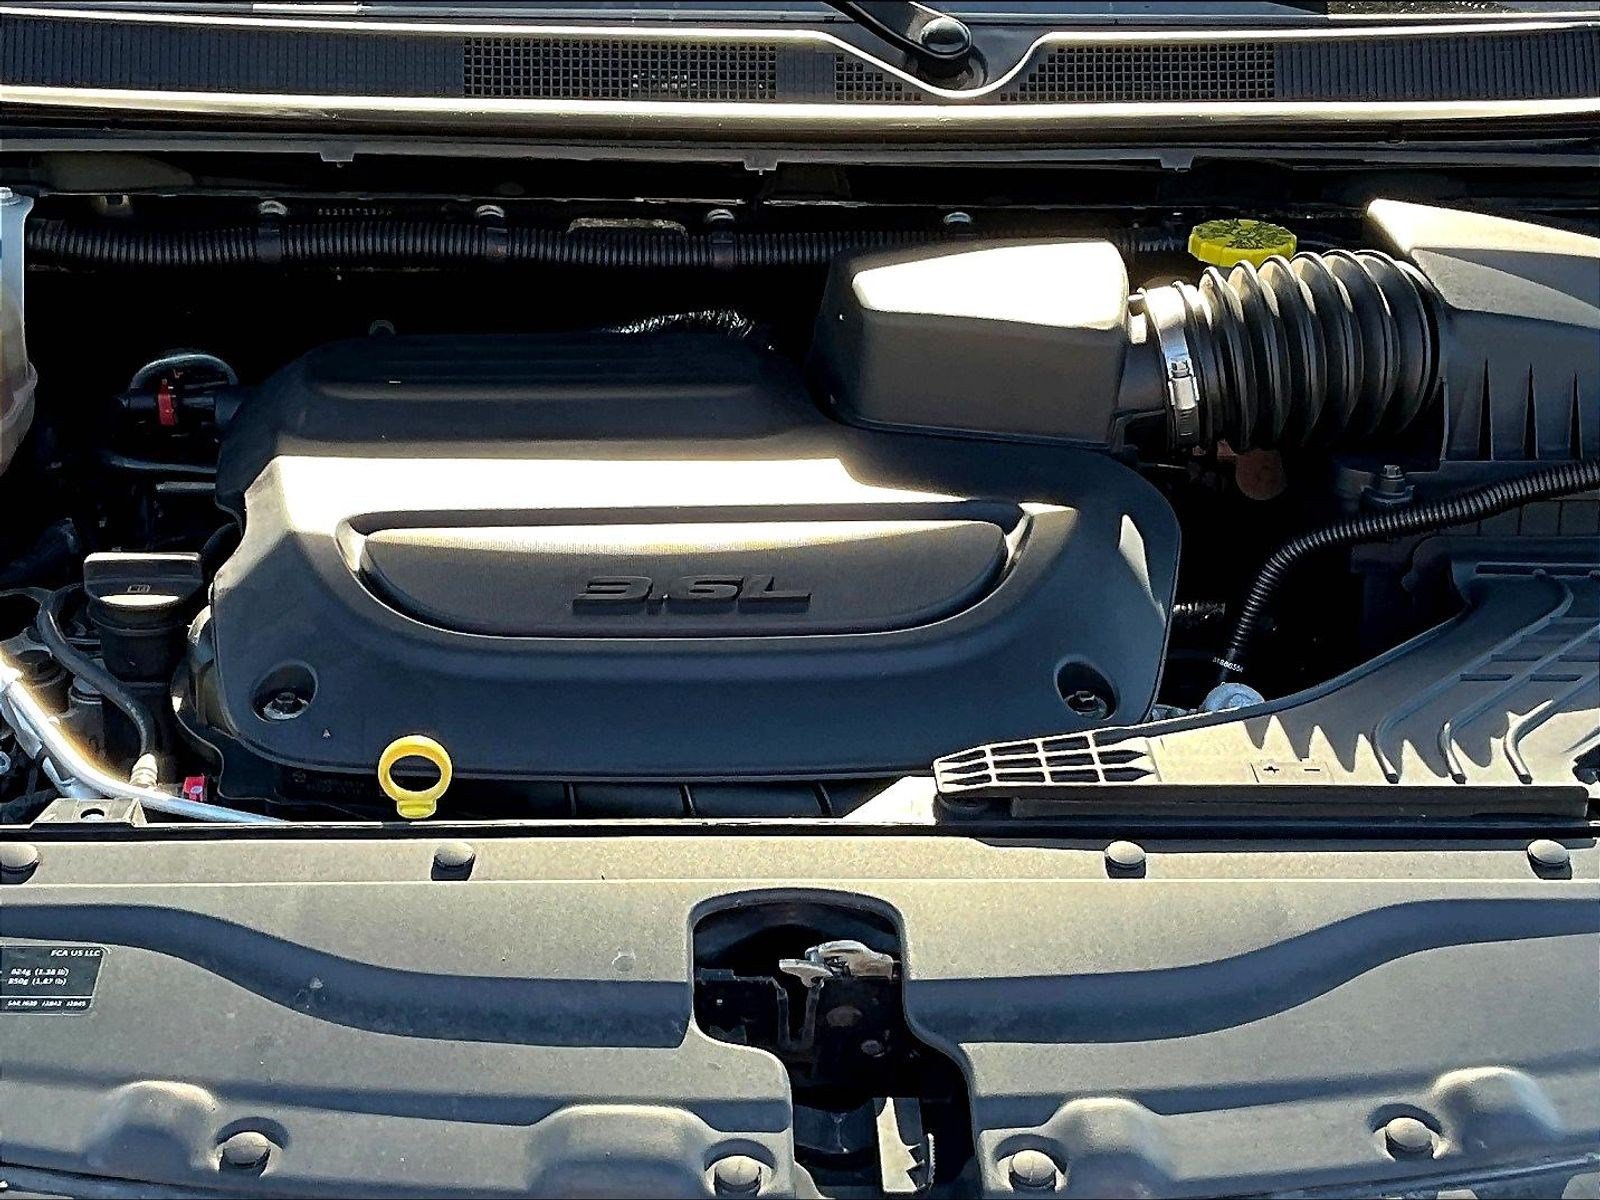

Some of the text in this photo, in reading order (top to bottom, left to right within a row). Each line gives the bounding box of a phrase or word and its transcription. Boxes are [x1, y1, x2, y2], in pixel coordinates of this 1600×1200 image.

[573, 575, 812, 609] 3.6L
[50, 949, 101, 957] FCA US LLC
